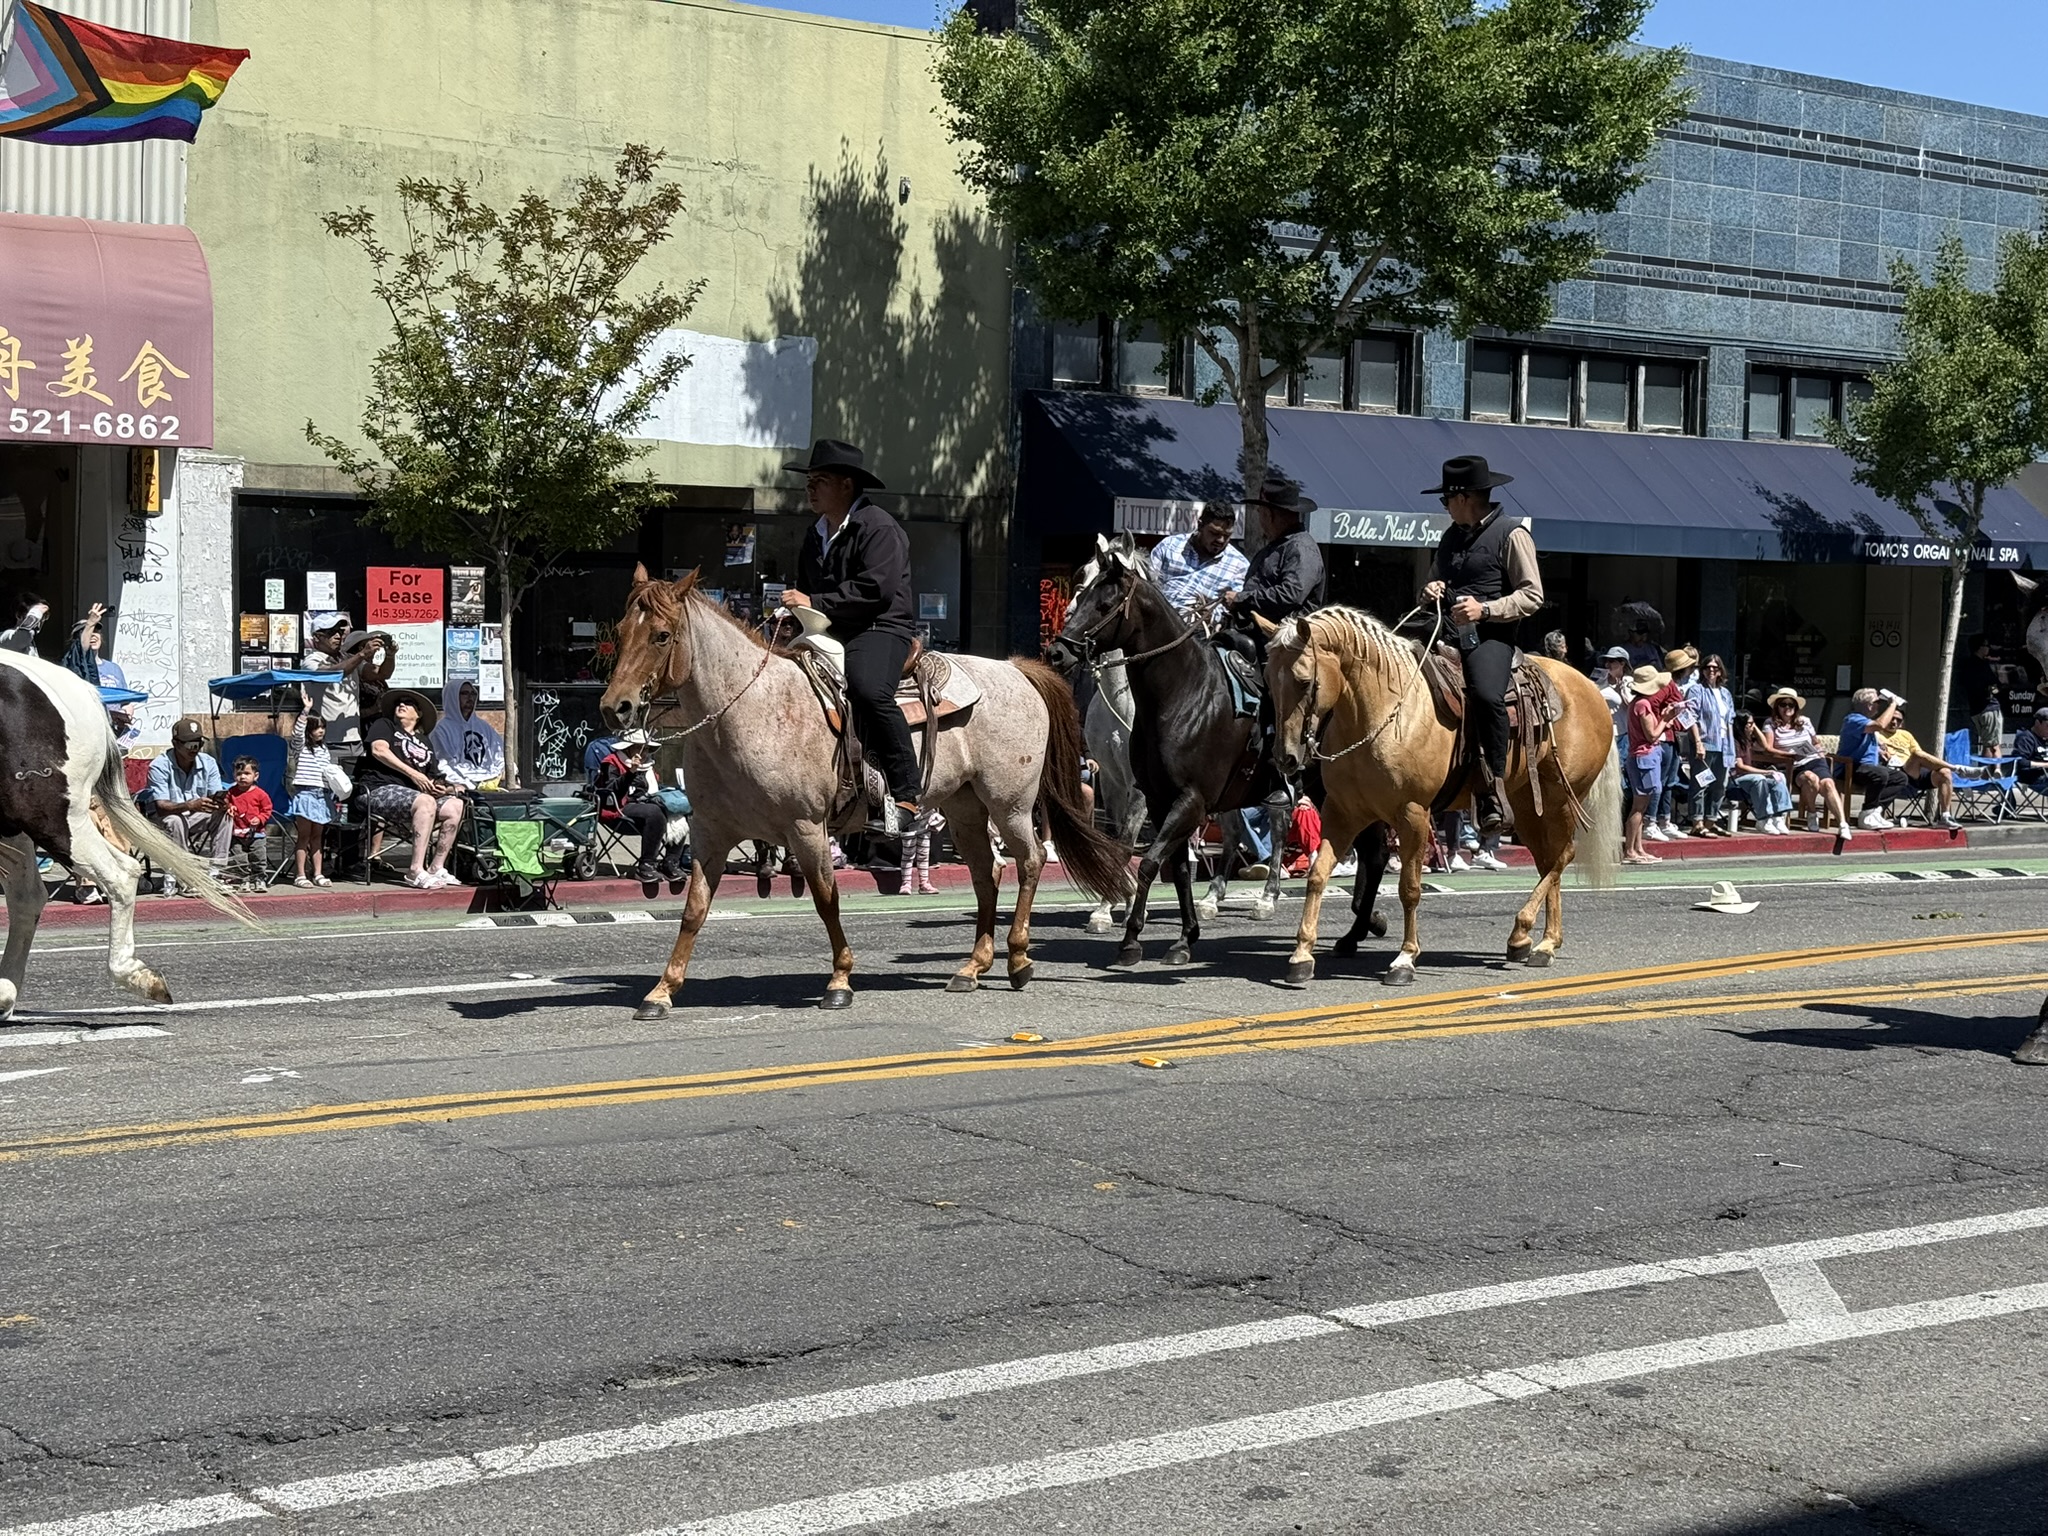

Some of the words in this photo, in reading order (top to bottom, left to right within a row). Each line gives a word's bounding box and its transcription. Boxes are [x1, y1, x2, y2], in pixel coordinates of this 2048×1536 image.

[8, 407, 180, 441] 521-6862
[143, 455, 156, 505] ARK
[1121, 504, 1171, 531] LITTLE
[1333, 512, 1378, 540] Bella
[1378, 514, 1416, 542] Nail
[1417, 518, 1443, 547] Spa
[1864, 542, 1909, 559] TOMO'S
[1913, 543, 1968, 561] ORGA
[1971, 547, 1996, 562] NAIL
[1999, 547, 2019, 563] SPA
[390, 570, 422, 586] For
[378, 588, 433, 604] Lease
[371, 608, 440, 619] 415.395.7262
[398, 631, 419, 641] Choi
[429, 677, 441, 685] JLL
[2008, 690, 2036, 702] Sunday
[2011, 703, 2020, 714] 10
[2020, 705, 2033, 714] am
